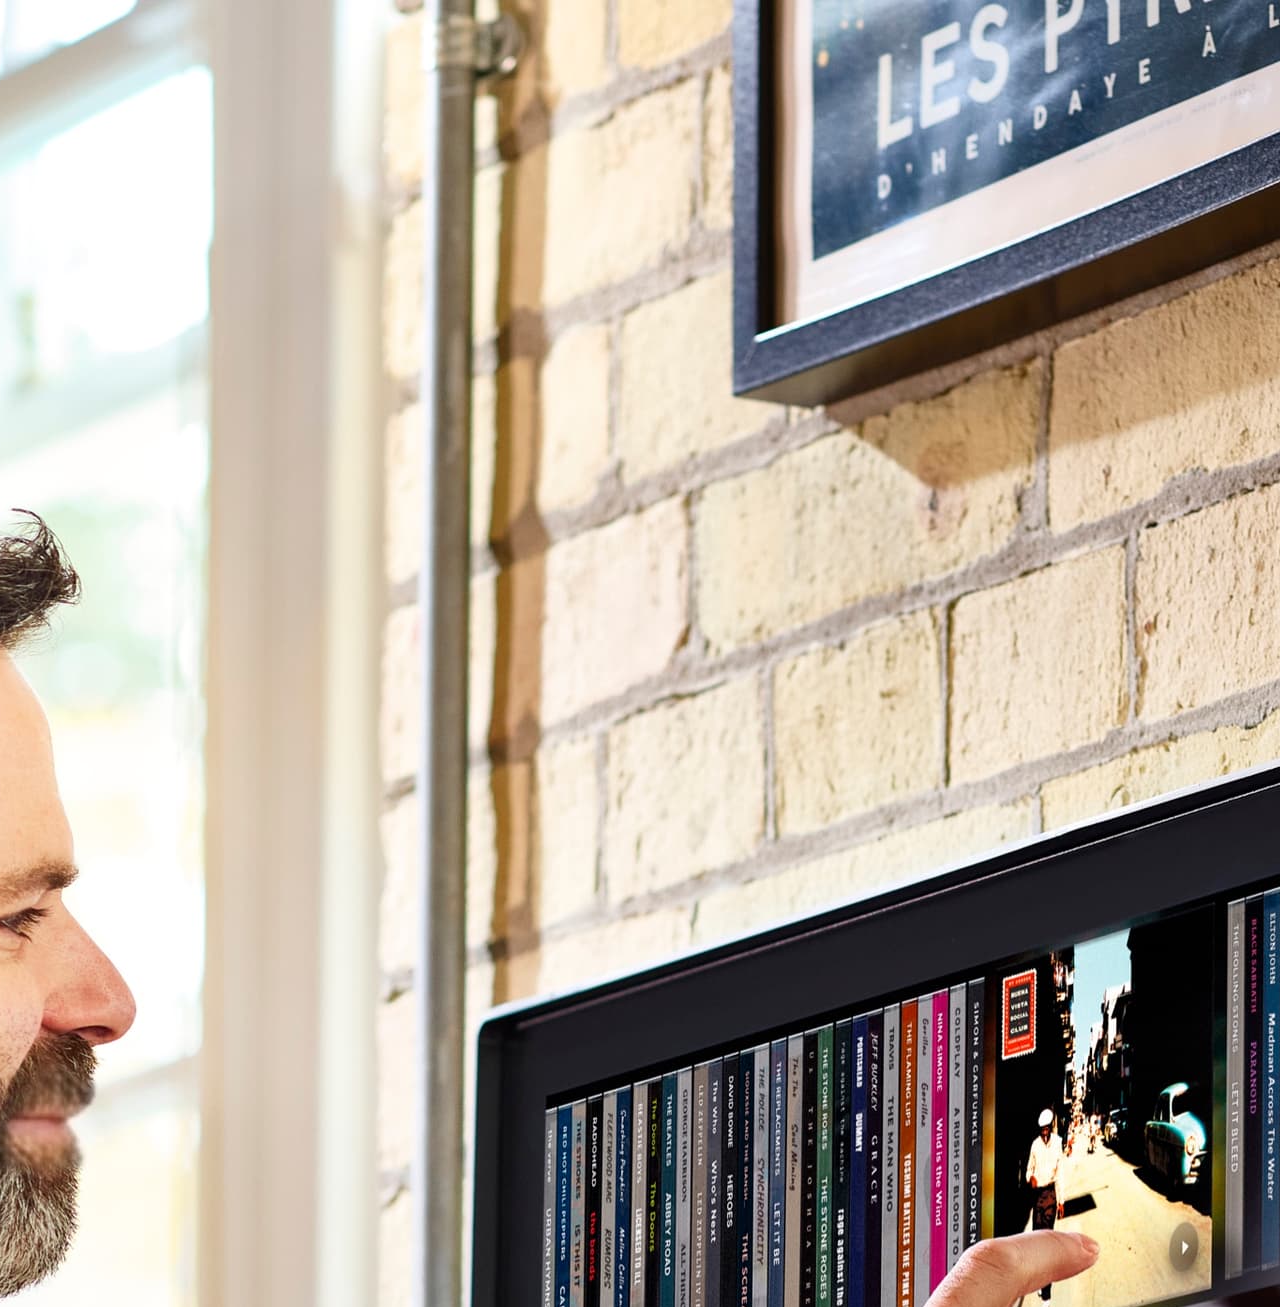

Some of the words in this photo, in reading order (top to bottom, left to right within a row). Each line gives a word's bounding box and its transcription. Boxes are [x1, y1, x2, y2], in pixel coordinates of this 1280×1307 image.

[877, 3, 1009, 149] LES
[1269, 912, 1277, 951] ELTON
[1269, 953, 1277, 985] JOHN
[906, 1022, 914, 1044] THE
[954, 1007, 962, 1078] COLDPLAY
[973, 1001, 981, 1046] SIMON
[1010, 1024, 1028, 1034] CLUB
[1268, 1013, 1276, 1073] Madman
[822, 1047, 830, 1069] THE
[888, 1027, 896, 1071] TRAVIS
[936, 1045, 944, 1091] SIMONE
[758, 1068, 766, 1089] THE
[905, 1047, 913, 1099] FLAMING
[651, 1098, 659, 1120] The
[666, 1094, 674, 1116] THE
[887, 1096, 895, 1127] THE
[954, 1107, 961, 1117] A
[1267, 1076, 1275, 1125] Across
[727, 1111, 735, 1148] BOWIE
[774, 1086, 782, 1176] REPLACEMENTS
[821, 1112, 829, 1151] ROSES
[855, 1112, 863, 1152] DUMMY
[936, 1118, 944, 1149] Wild
[953, 1120, 961, 1159] RUSH
[1267, 1128, 1276, 1154] The
[591, 1116, 599, 1188] RADIOHEAD
[887, 1131, 895, 1168] MAN
[936, 1151, 944, 1163] is
[711, 1159, 719, 1205] Who's
[871, 1135, 879, 1204] GRACE
[903, 1153, 912, 1199] YOSHIMI
[935, 1165, 943, 1188] the
[953, 1162, 961, 1180] OF
[1267, 1157, 1275, 1200] Water
[650, 1182, 658, 1208] The
[726, 1174, 734, 1228] HEROES
[821, 1176, 829, 1204] THE
[886, 1172, 894, 1213] WHO
[935, 1190, 943, 1226] Wind
[952, 1185, 960, 1233] BLOOD
[969, 1172, 978, 1244] BOOKEN
[664, 1192, 672, 1235] ABBEY
[710, 1209, 718, 1243] Next
[756, 1157, 765, 1265] SYNCHRONICITY
[773, 1202, 781, 1227] LET
[820, 1206, 828, 1252] STONE
[902, 1201, 911, 1246] BATTLES
[560, 1210, 568, 1261] PEPPERS
[574, 1224, 582, 1238] IS
[649, 1211, 657, 1253] Doors
[773, 1231, 781, 1244] IT
[952, 1237, 960, 1256] TO
[574, 1239, 582, 1272] THIS
[589, 1238, 597, 1281] bends
[604, 1228, 612, 1289] RUMOURS
[664, 1239, 672, 1276] ROAD
[773, 1248, 781, 1266] BE
[902, 1248, 910, 1268] THE
[574, 1275, 581, 1287] IT
[820, 1254, 828, 1300] ROSES
